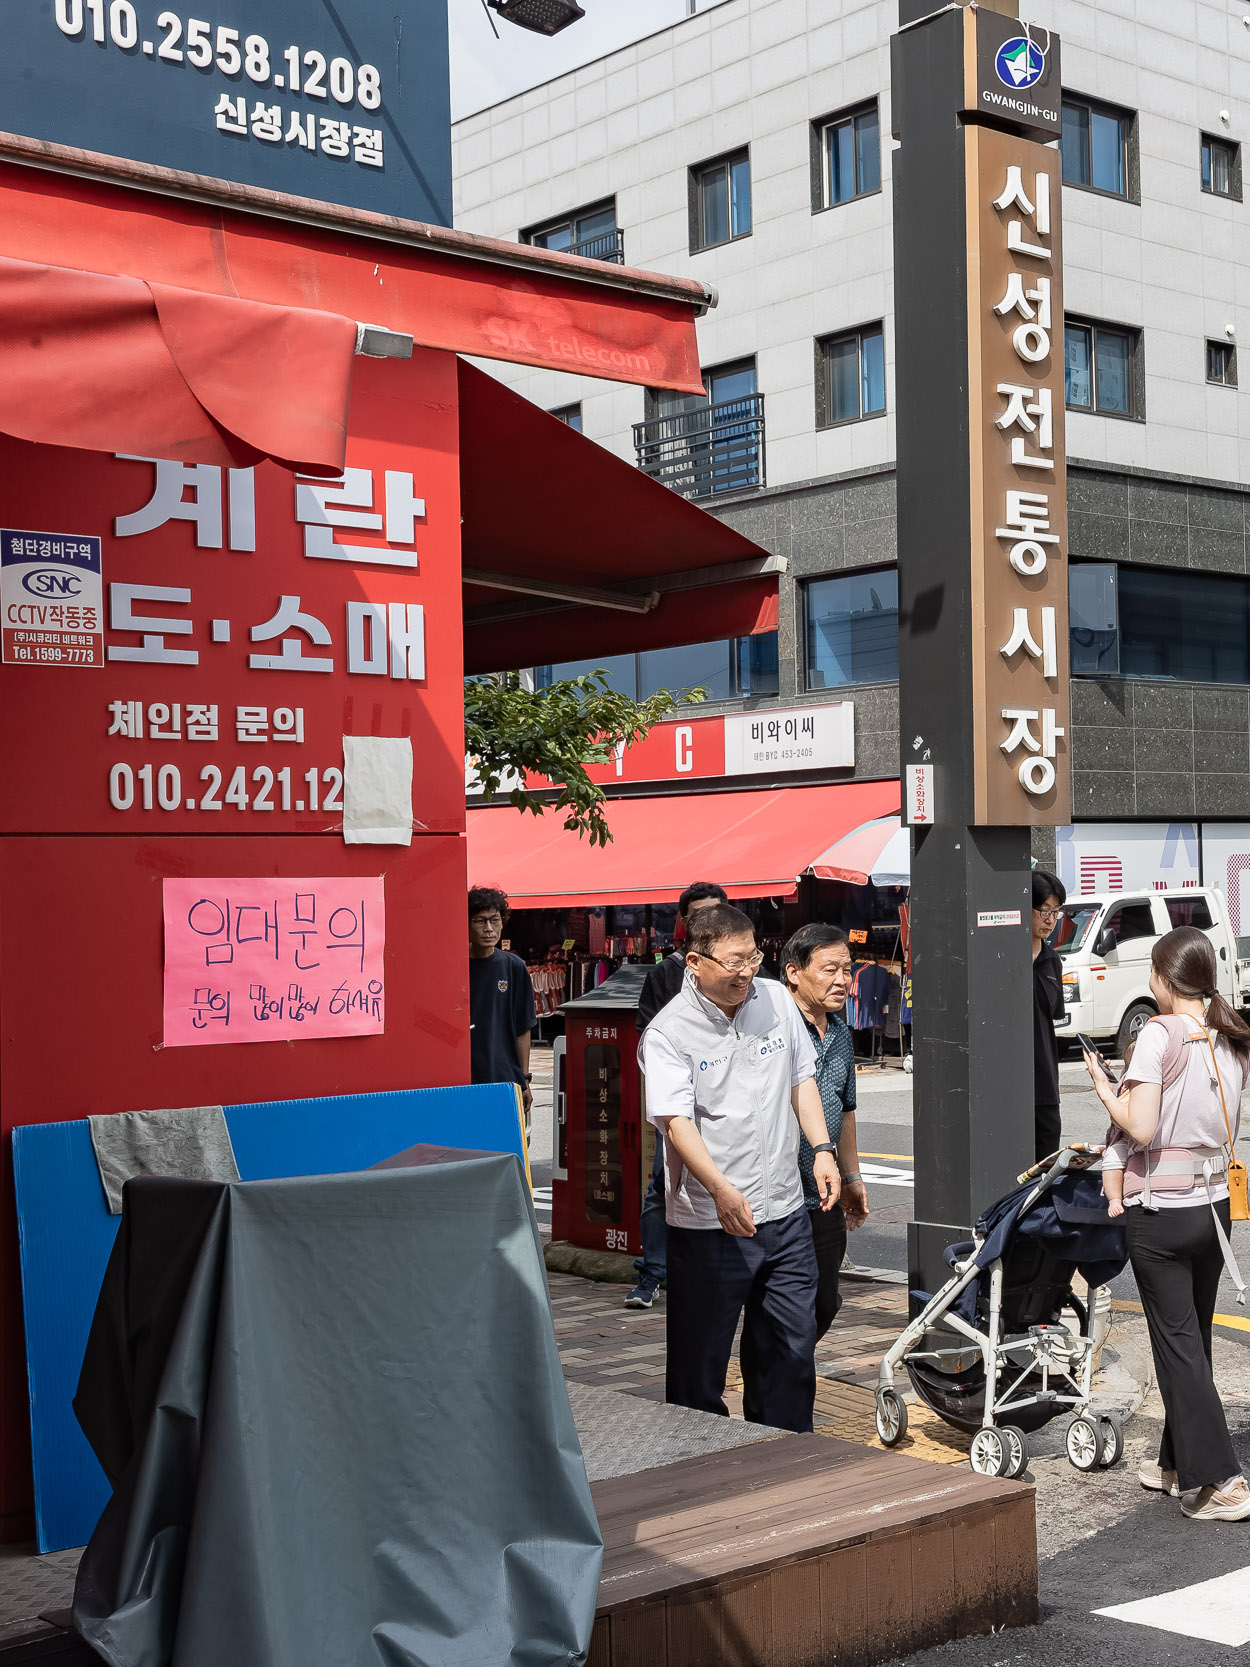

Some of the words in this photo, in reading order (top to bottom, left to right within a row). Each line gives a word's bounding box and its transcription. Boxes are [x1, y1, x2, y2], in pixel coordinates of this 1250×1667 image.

[54, 0, 382, 110] 010.2558.1208
[982, 90, 1058, 122] GWANGJIN-GU
[213, 93, 385, 168] 신성시장점
[546, 333, 651, 372] telecom
[991, 165, 1065, 796] 신성전통시장
[10, 538, 91, 560] 첨단경비구역
[35, 574, 83, 594] SNC
[7, 603, 97, 630] CCTV작동중
[13, 646, 94, 663] Tel.1599-7773
[14, 631, 60, 644] (주)시큐리티
[62, 634, 93, 645] 네트워크
[107, 699, 220, 742] 체인점
[235, 705, 305, 743] 문의
[751, 716, 815, 744] 비와이씨
[765, 750, 778, 761] BYC
[781, 747, 813, 759] 453-2405
[109, 762, 344, 811] 010.2421.12
[915, 768, 926, 813] 비상소화장치
[188, 892, 366, 973] 임대문의
[188, 987, 231, 1029] 문의
[249, 983, 284, 1021] 많이
[288, 983, 320, 1022] 많이
[585, 1027, 618, 1040] 주차금지
[598, 1067, 609, 1187] 비상소화장치
[605, 1228, 629, 1251] 광진
